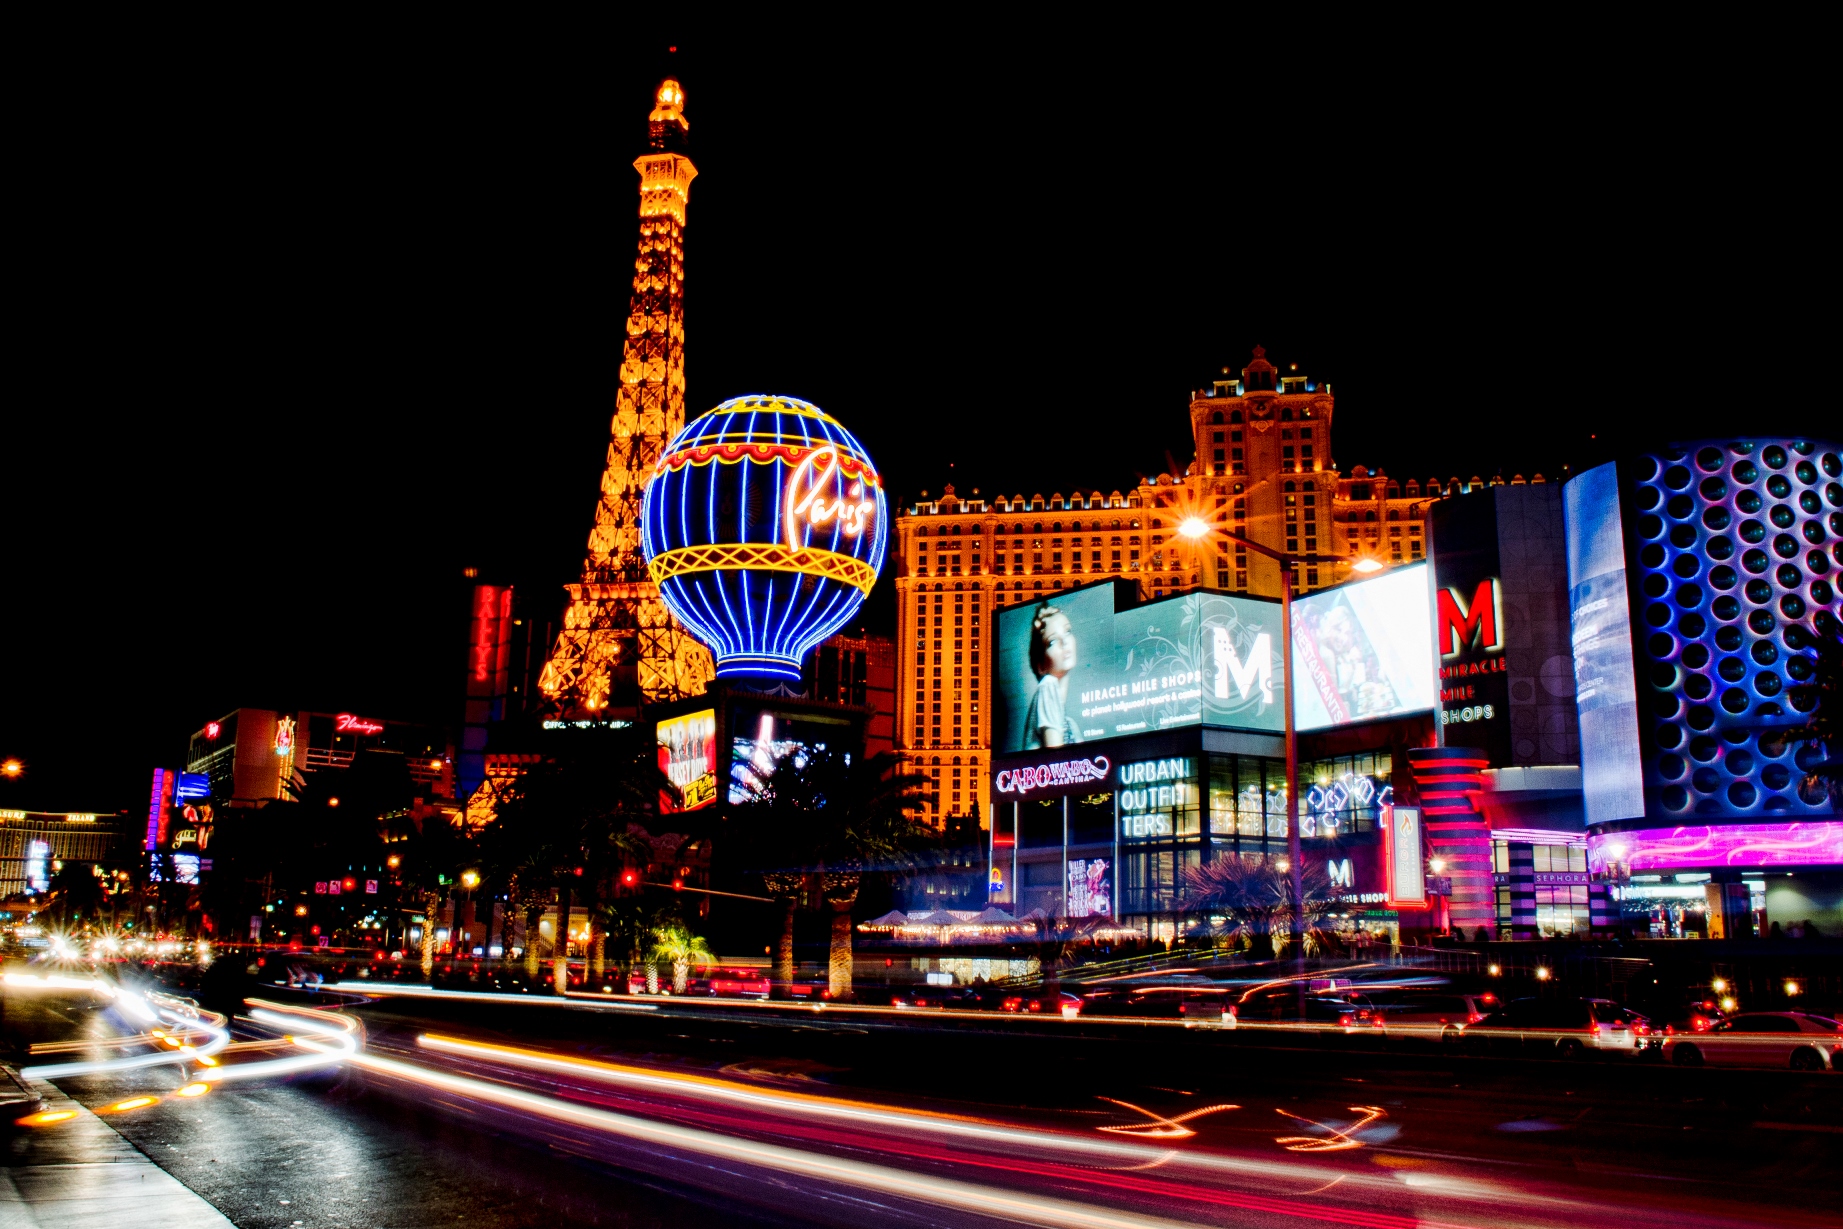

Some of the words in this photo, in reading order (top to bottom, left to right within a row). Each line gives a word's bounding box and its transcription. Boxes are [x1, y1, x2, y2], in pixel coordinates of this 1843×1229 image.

[786, 445, 874, 553] Paris
[1437, 577, 1505, 660] M
[1213, 625, 1272, 704] M
[1294, 625, 1344, 724] RESTAURANTS
[1438, 656, 1508, 680] MIRACLE
[1082, 684, 1127, 703] MIRACLE
[1131, 678, 1157, 694] MILE
[1162, 670, 1201, 687] SHOPS
[1439, 685, 1475, 702] MILE
[1091, 704, 1112, 717] planet
[1112, 696, 1146, 713] hollywood
[1146, 693, 1171, 705] resort
[1171, 692, 1178, 701] &
[1177, 688, 1201, 700] casino
[1441, 704, 1495, 725] SHOPS
[337, 713, 384, 735] Flamingo
[1121, 758, 1185, 785] URBAN
[1121, 783, 1185, 811] OUTFIT
[1122, 813, 1166, 838] TERS
[1328, 858, 1354, 888] M
[1536, 874, 1588, 882] SEPHORA
[1360, 892, 1390, 903] SHOPS
